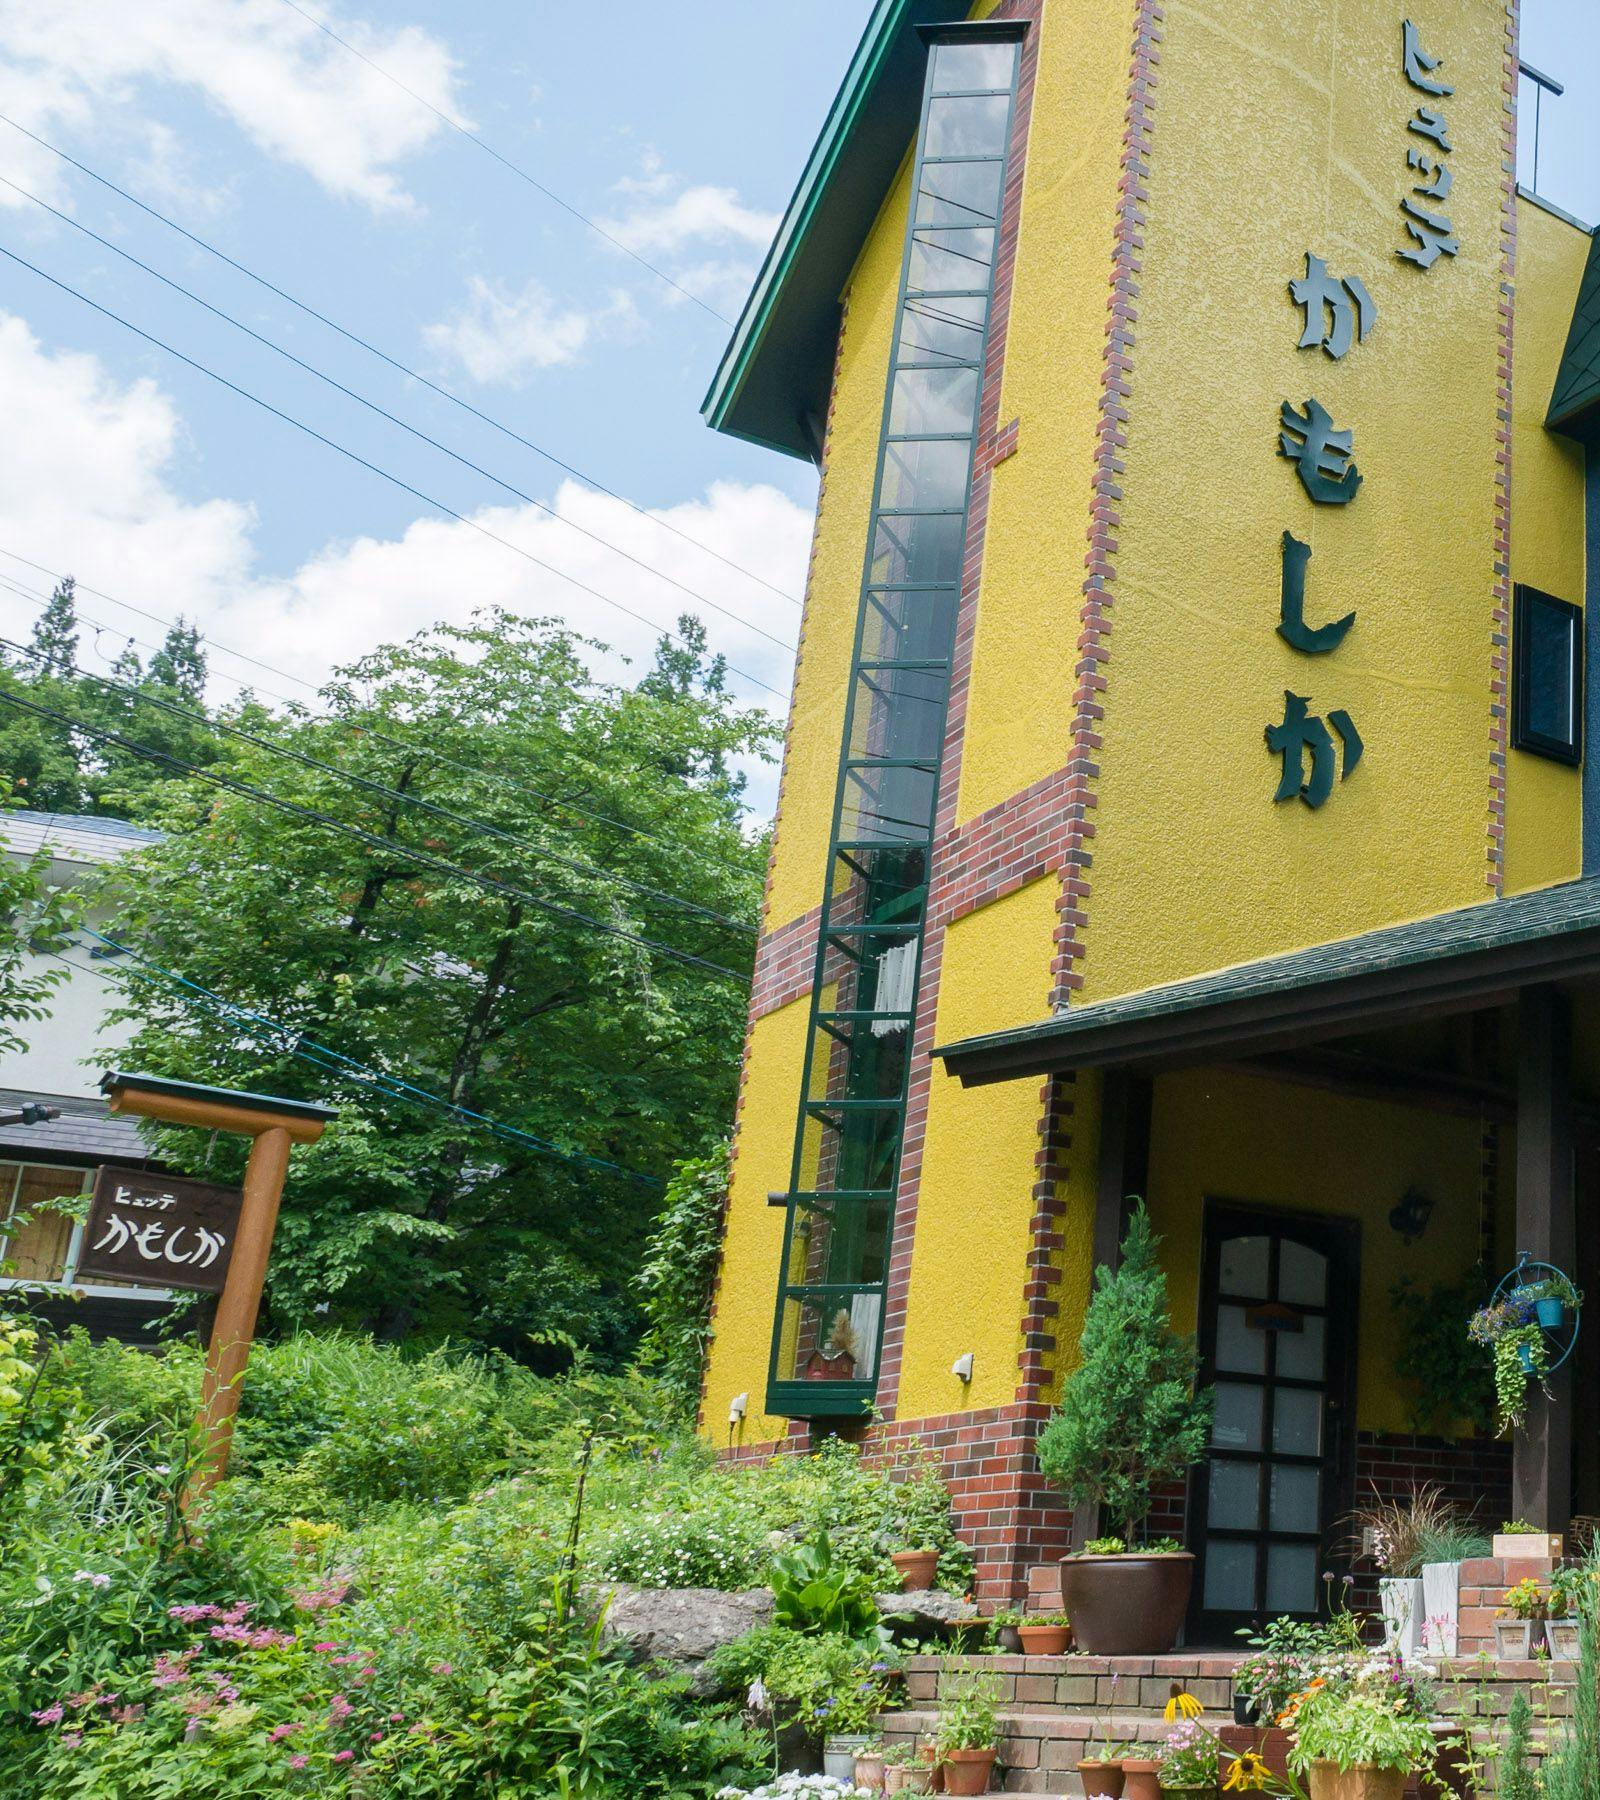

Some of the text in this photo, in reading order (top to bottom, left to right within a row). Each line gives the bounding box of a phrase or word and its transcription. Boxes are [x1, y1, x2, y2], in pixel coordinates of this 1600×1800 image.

[1264, 250, 1378, 809] かもしか
[115, 1186, 176, 1210] ヒュッテ
[92, 1213, 226, 1268] かもしか
